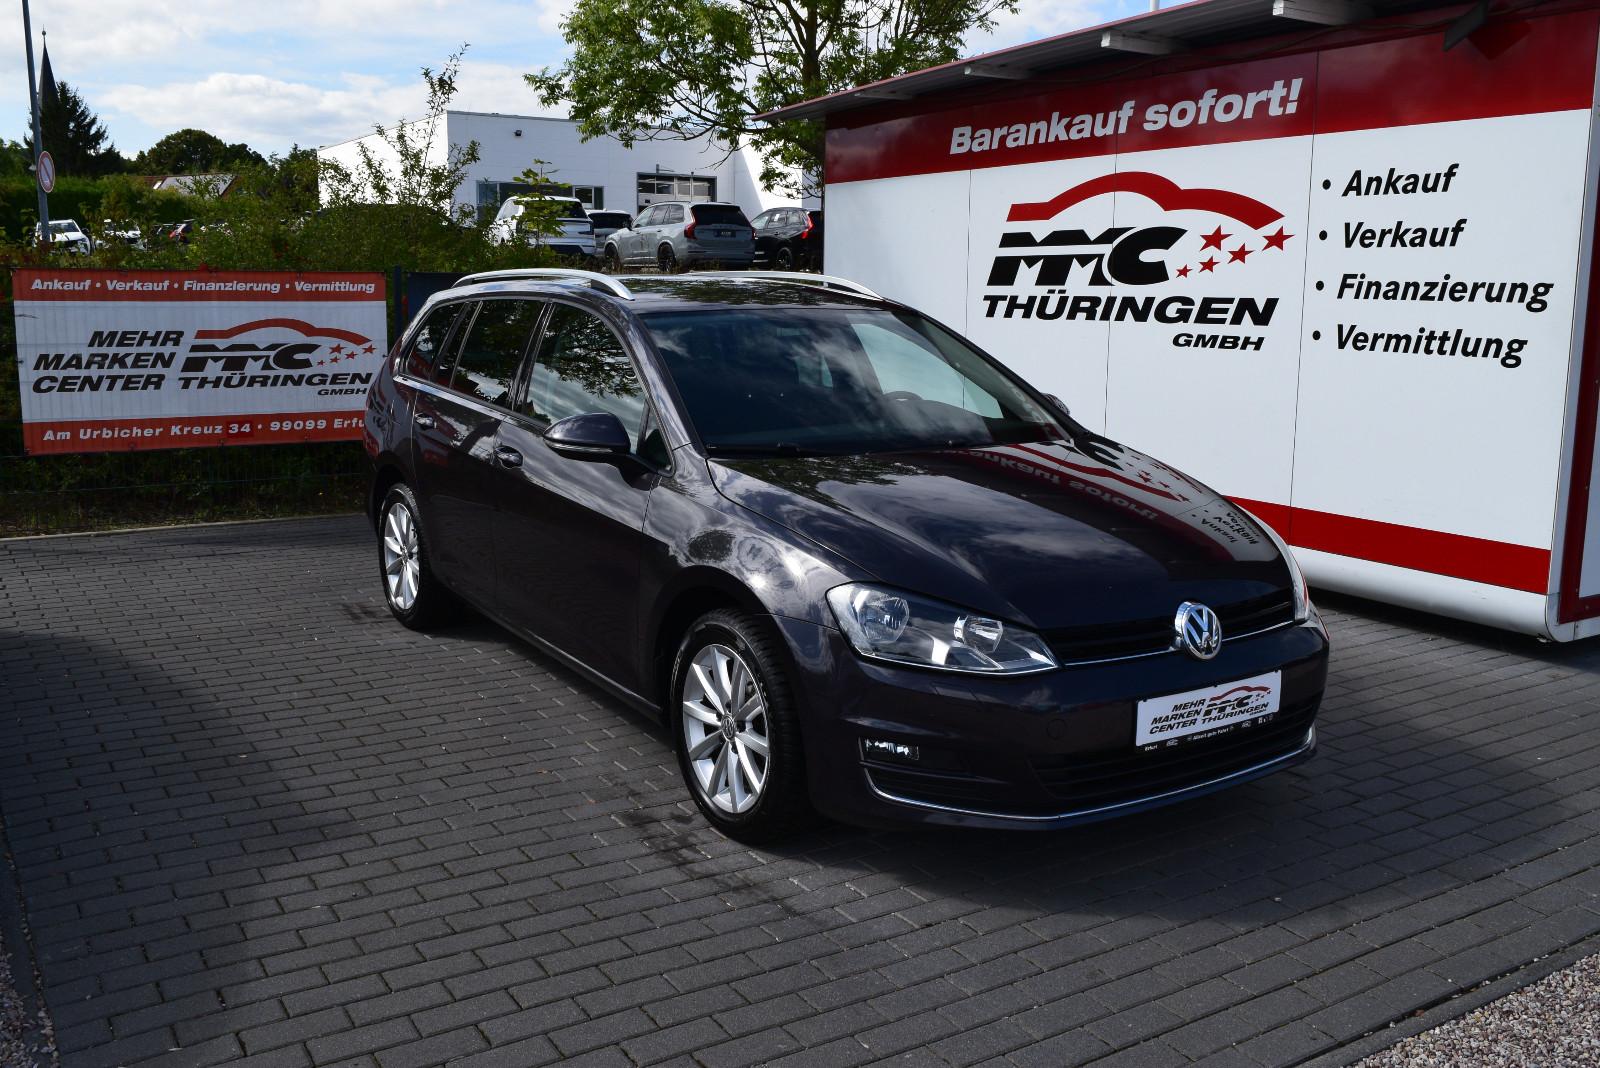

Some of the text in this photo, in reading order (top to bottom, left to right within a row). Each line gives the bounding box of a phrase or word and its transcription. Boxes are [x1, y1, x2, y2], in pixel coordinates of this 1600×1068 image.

[949, 78, 1303, 155] Barankauf sofort!
[1341, 163, 1460, 197] Ankauf
[1344, 218, 1467, 249] Verkauf
[986, 226, 1188, 286] MMC
[31, 278, 376, 294] Ankauf Verkauf Finanzierung Vermittlung
[1336, 273, 1554, 313] Finanzierung
[982, 289, 1279, 327] THÜRINGEN
[87, 330, 185, 348] MEHR
[1172, 333, 1265, 351] GMBH
[1336, 323, 1528, 369] Vermittlung
[32, 351, 177, 371] MARKEN
[32, 372, 373, 394] CENTER THÜRINGEN
[317, 388, 368, 397] GMBH
[43, 429, 71, 442] Am
[79, 426, 164, 440] Urbicher
[170, 424, 224, 436] Kreuz
[228, 423, 251, 434] 34
[269, 419, 328, 432] 99099
[1150, 707, 1203, 726] MARKEN
[1171, 698, 1207, 713] MEHR
[1149, 718, 1198, 735] CENTER
